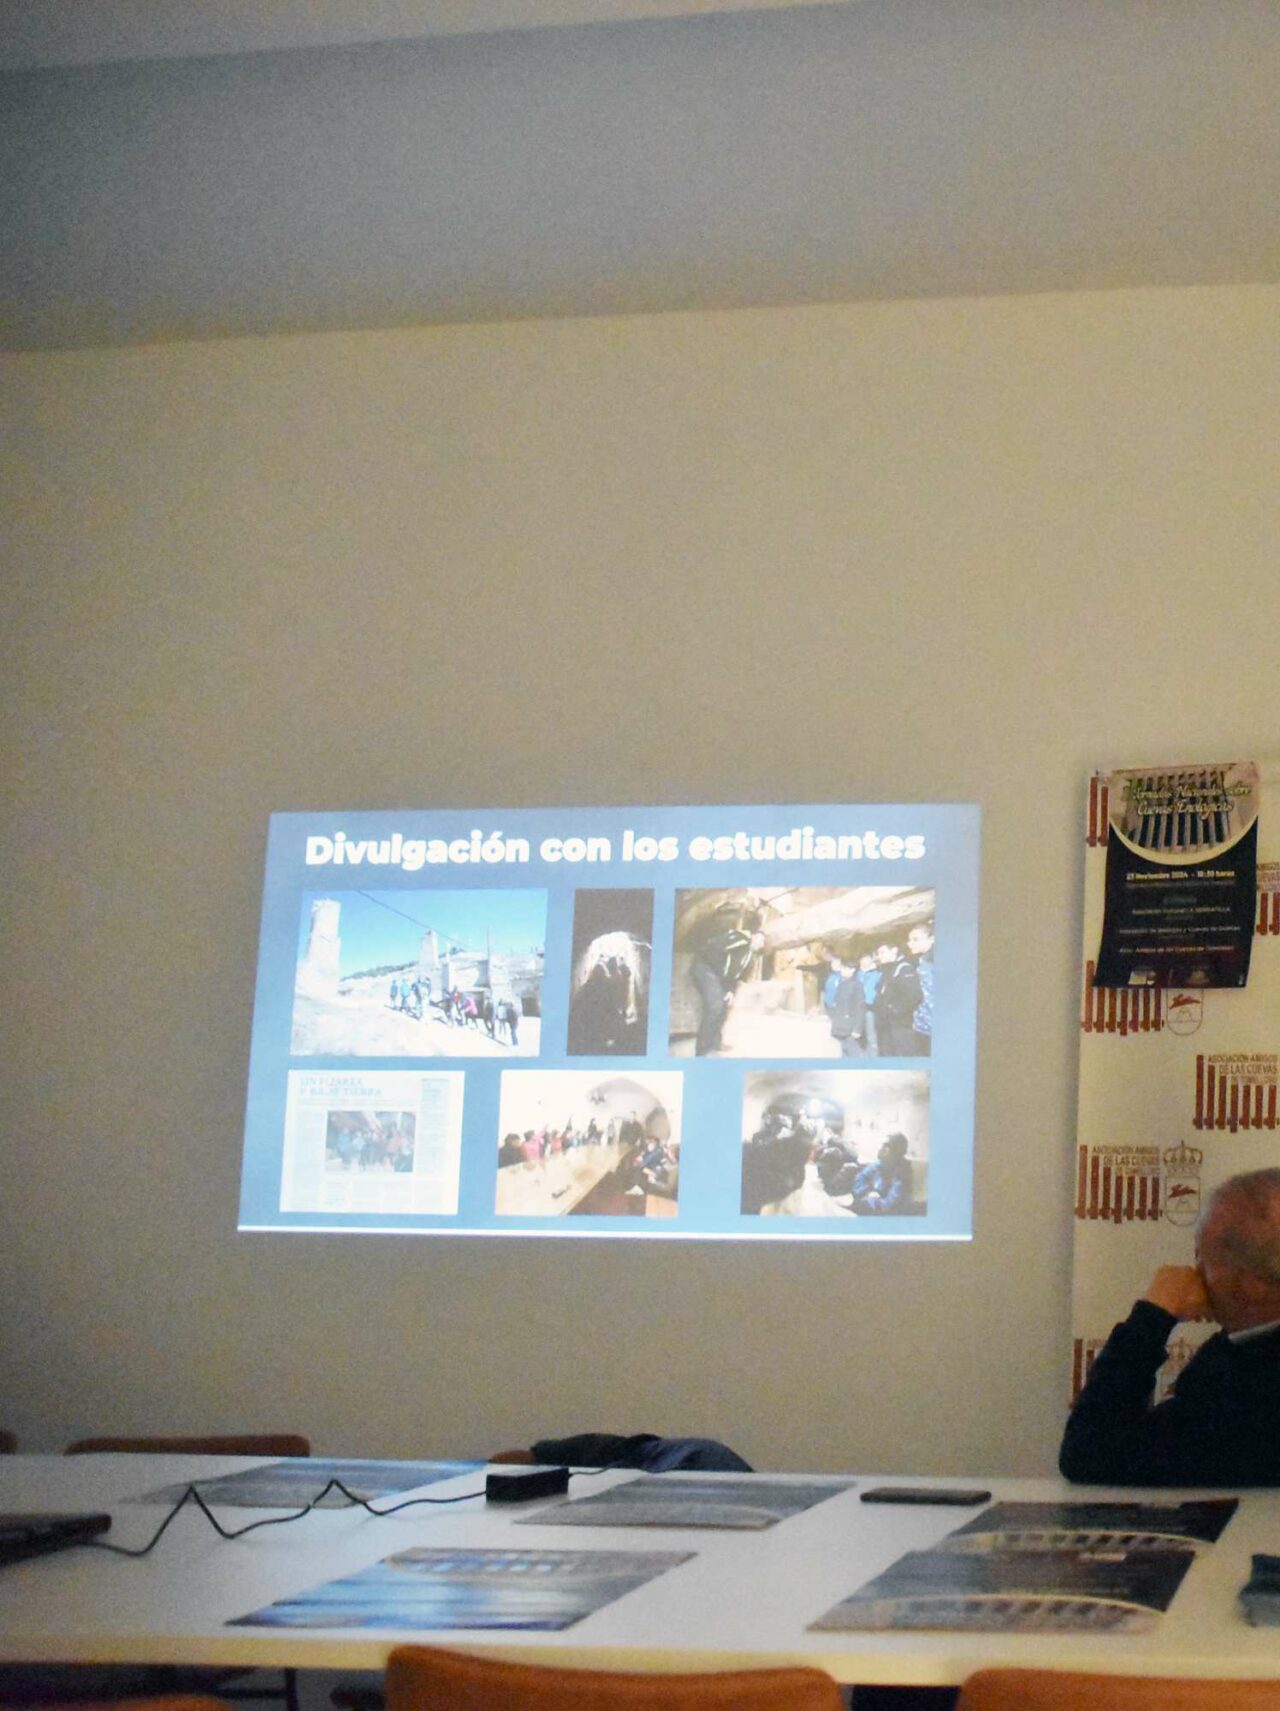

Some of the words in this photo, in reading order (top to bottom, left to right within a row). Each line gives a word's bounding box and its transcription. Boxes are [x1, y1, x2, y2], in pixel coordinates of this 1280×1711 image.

[305, 830, 530, 872] Divulgación
[539, 836, 612, 863] con
[621, 829, 680, 862] los
[688, 825, 926, 862] estudiantes
